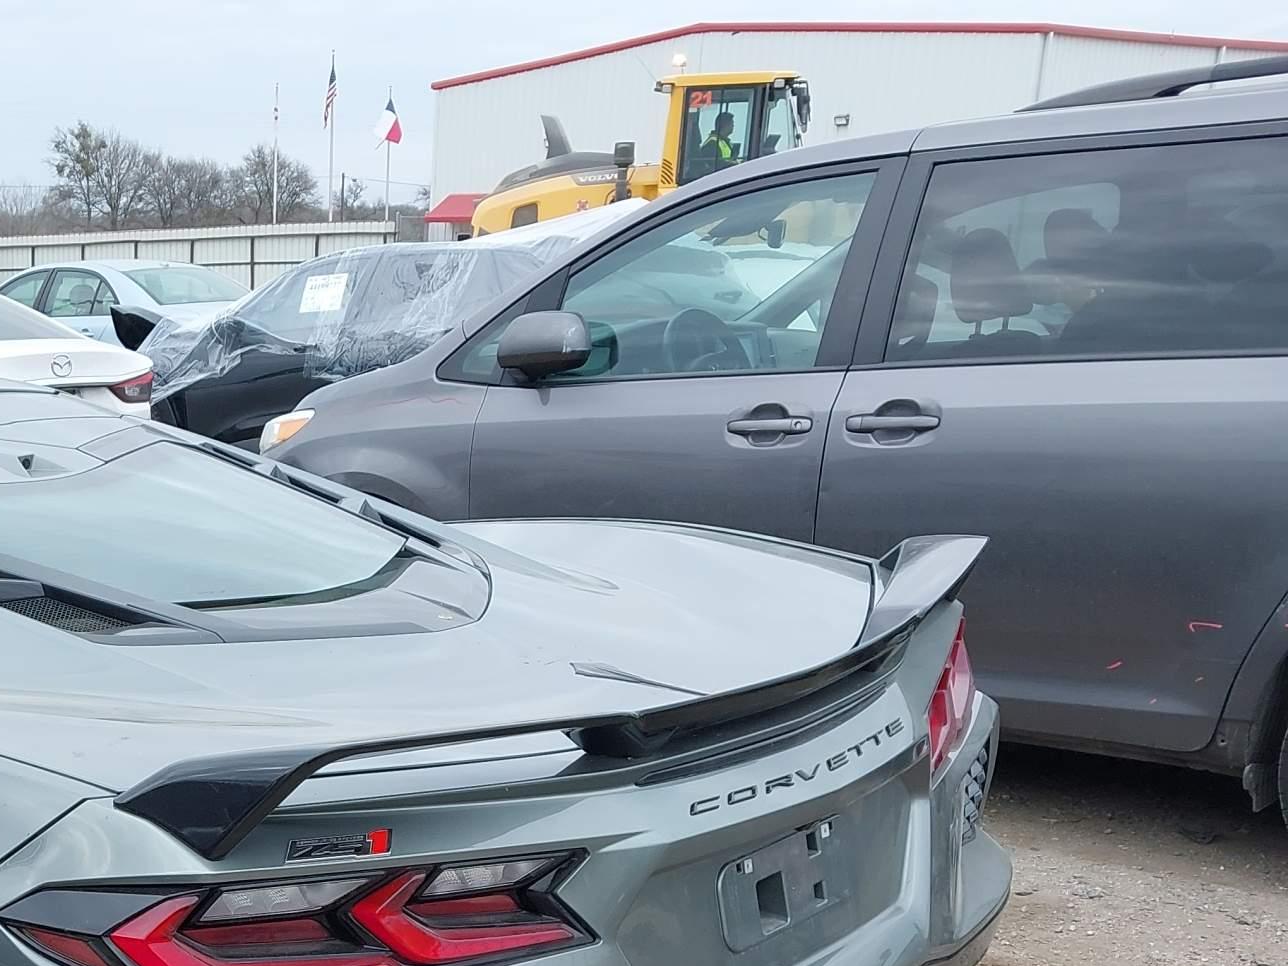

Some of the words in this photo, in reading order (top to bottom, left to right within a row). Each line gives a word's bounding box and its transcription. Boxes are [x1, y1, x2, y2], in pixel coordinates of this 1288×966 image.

[690, 88, 712, 108] 21
[578, 173, 620, 183] VOLV
[689, 717, 905, 817] CORVETTE
